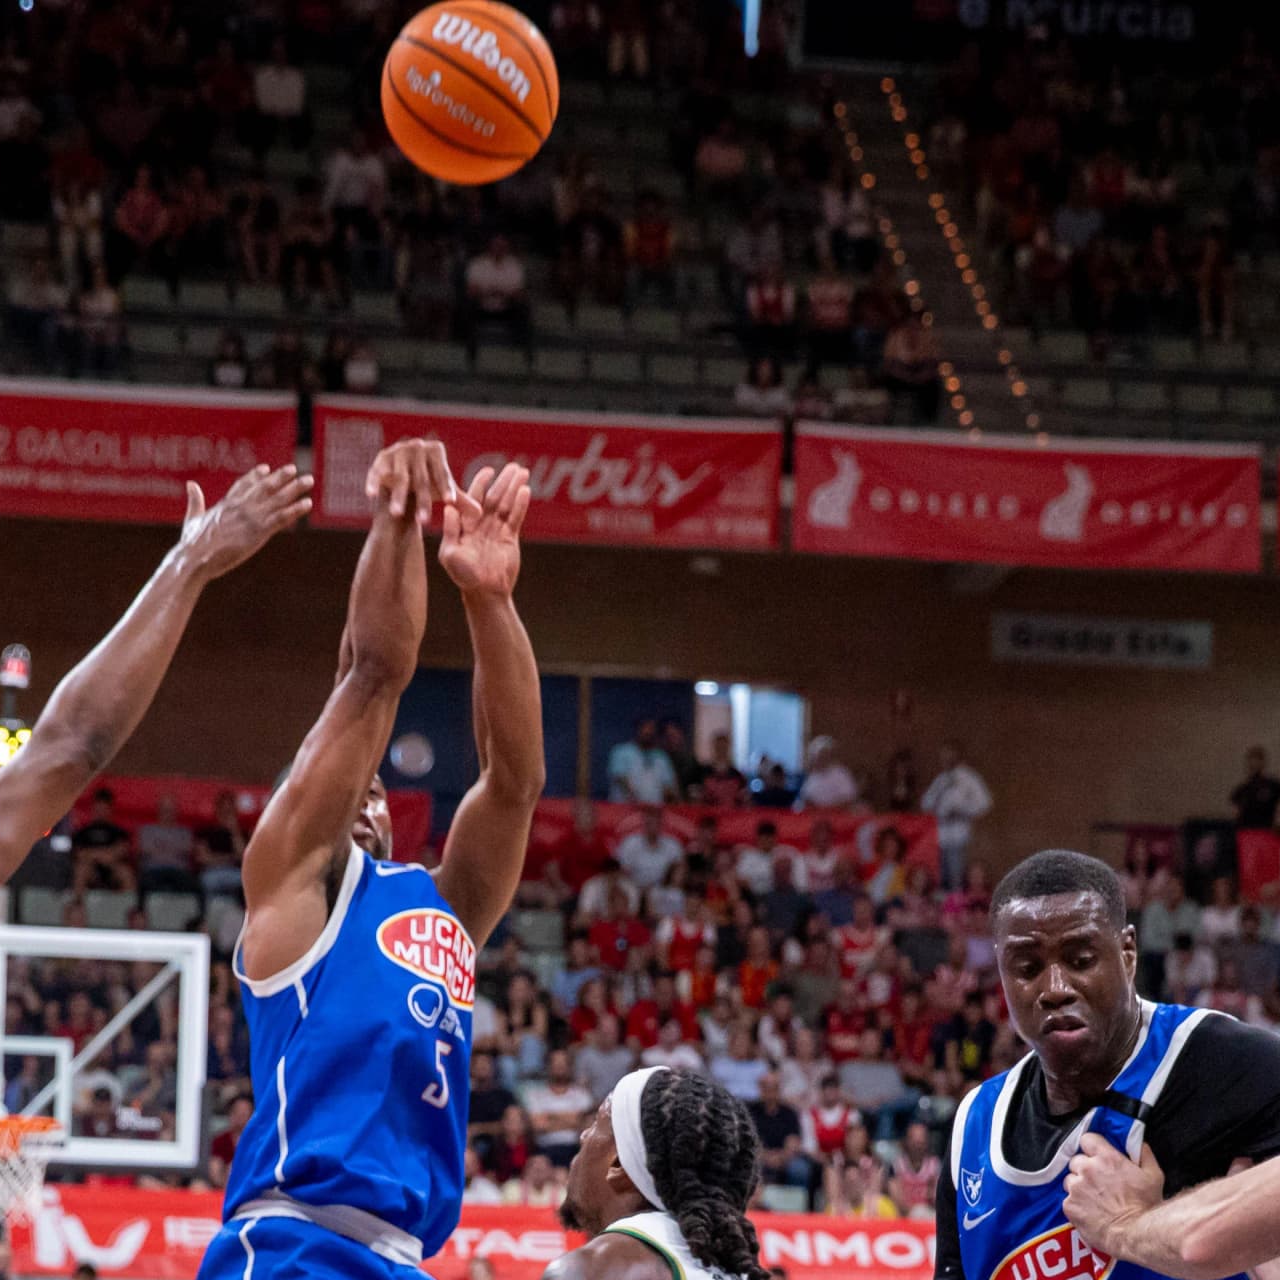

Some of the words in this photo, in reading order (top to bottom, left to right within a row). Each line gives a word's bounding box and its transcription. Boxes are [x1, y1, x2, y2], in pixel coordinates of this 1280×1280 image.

[432, 13, 531, 103] Wilson
[409, 915, 475, 974] UCAM
[422, 1039, 452, 1109] 5
[436, 1227, 567, 1259] TAE
